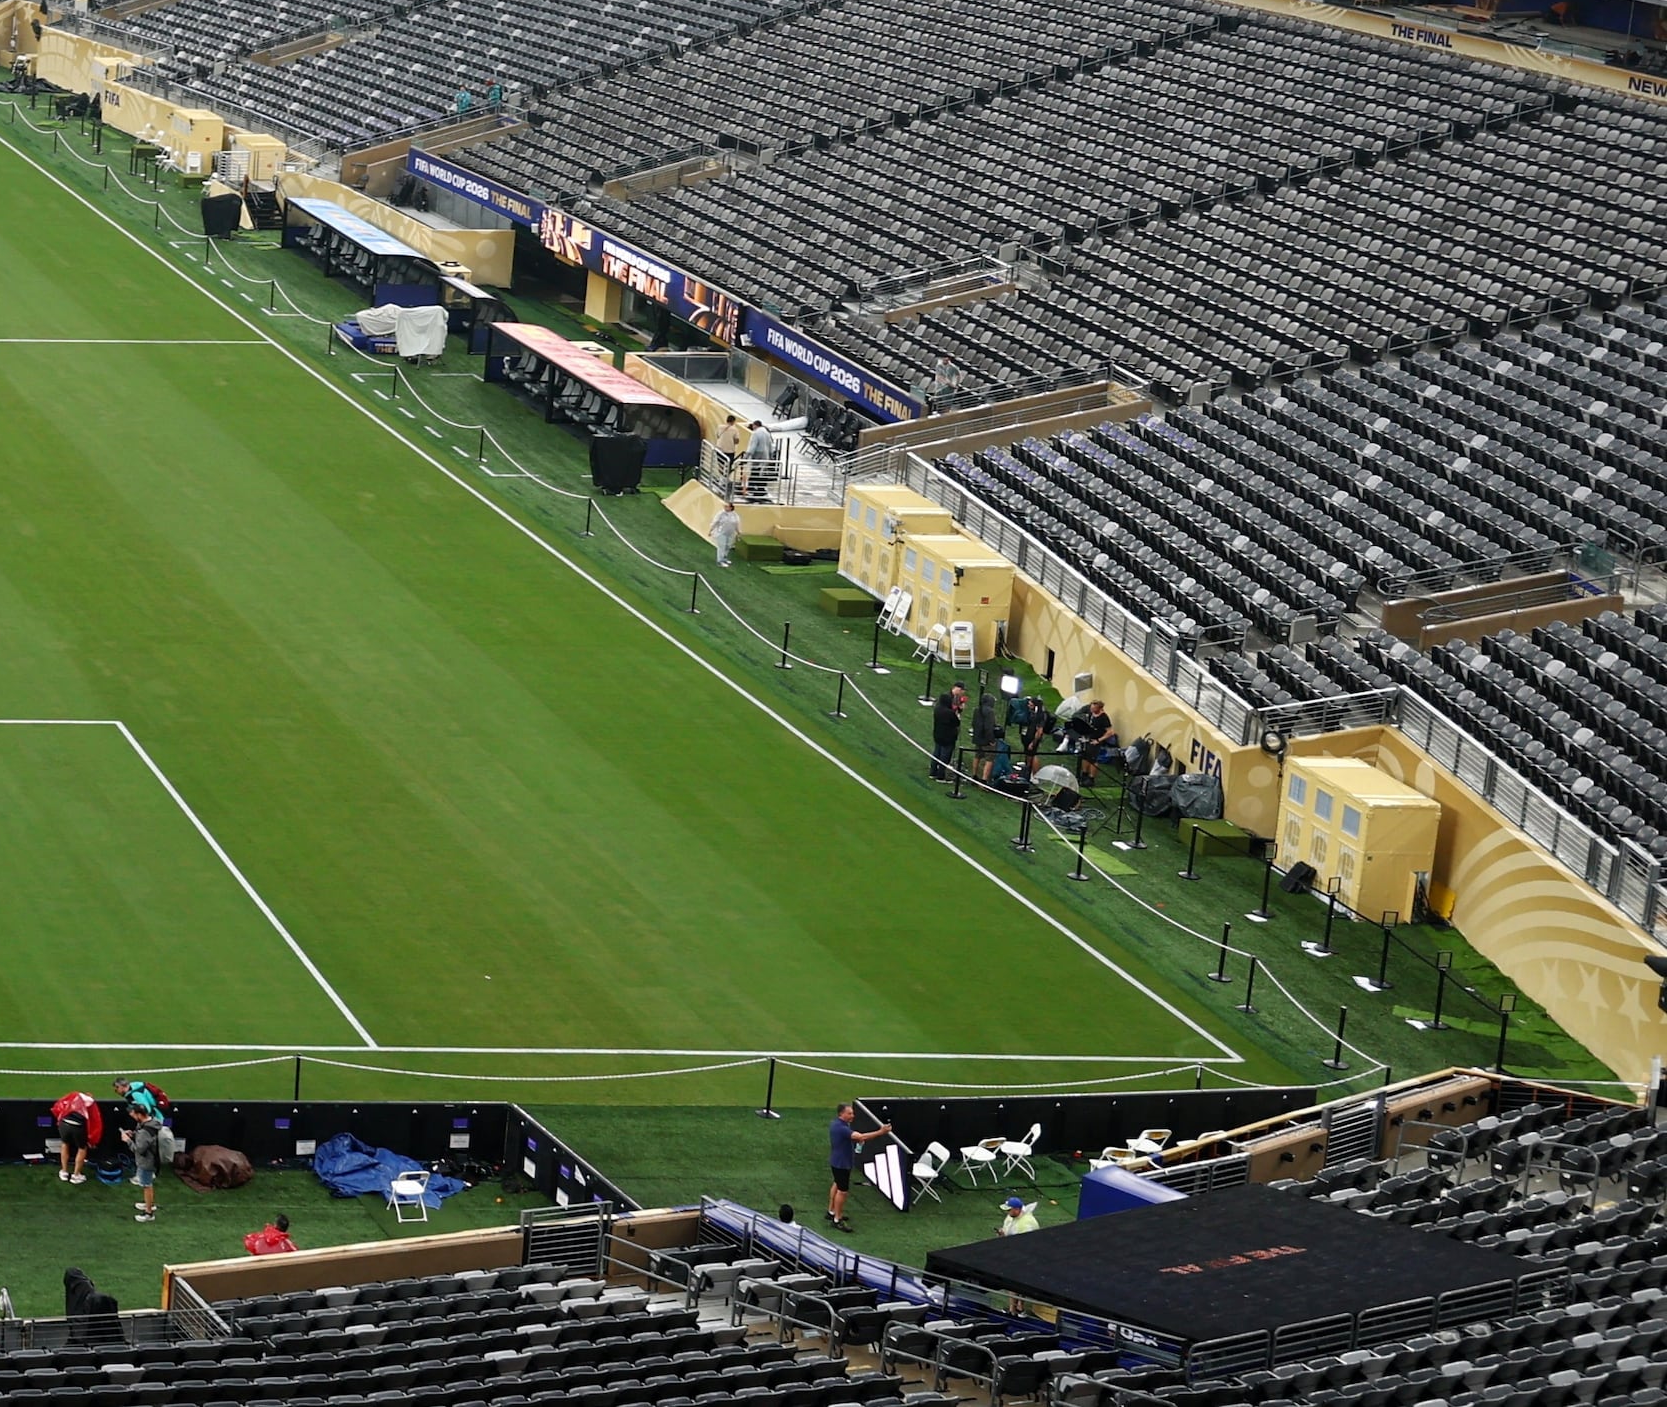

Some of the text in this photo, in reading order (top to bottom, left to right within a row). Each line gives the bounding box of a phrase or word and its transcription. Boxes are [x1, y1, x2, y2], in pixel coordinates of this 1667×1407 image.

[1391, 23, 1454, 49] THE FINAL
[105, 90, 120, 107] FIFA
[1628, 76, 1667, 99] NEW
[415, 158, 532, 220] FIFA WORLD CUP 2026 THE FINAL
[602, 253, 668, 304] THE FINAL
[767, 328, 913, 421] FIFA WORLD CUP 2026 THE FINAL
[1190, 738, 1223, 784] FIFA
